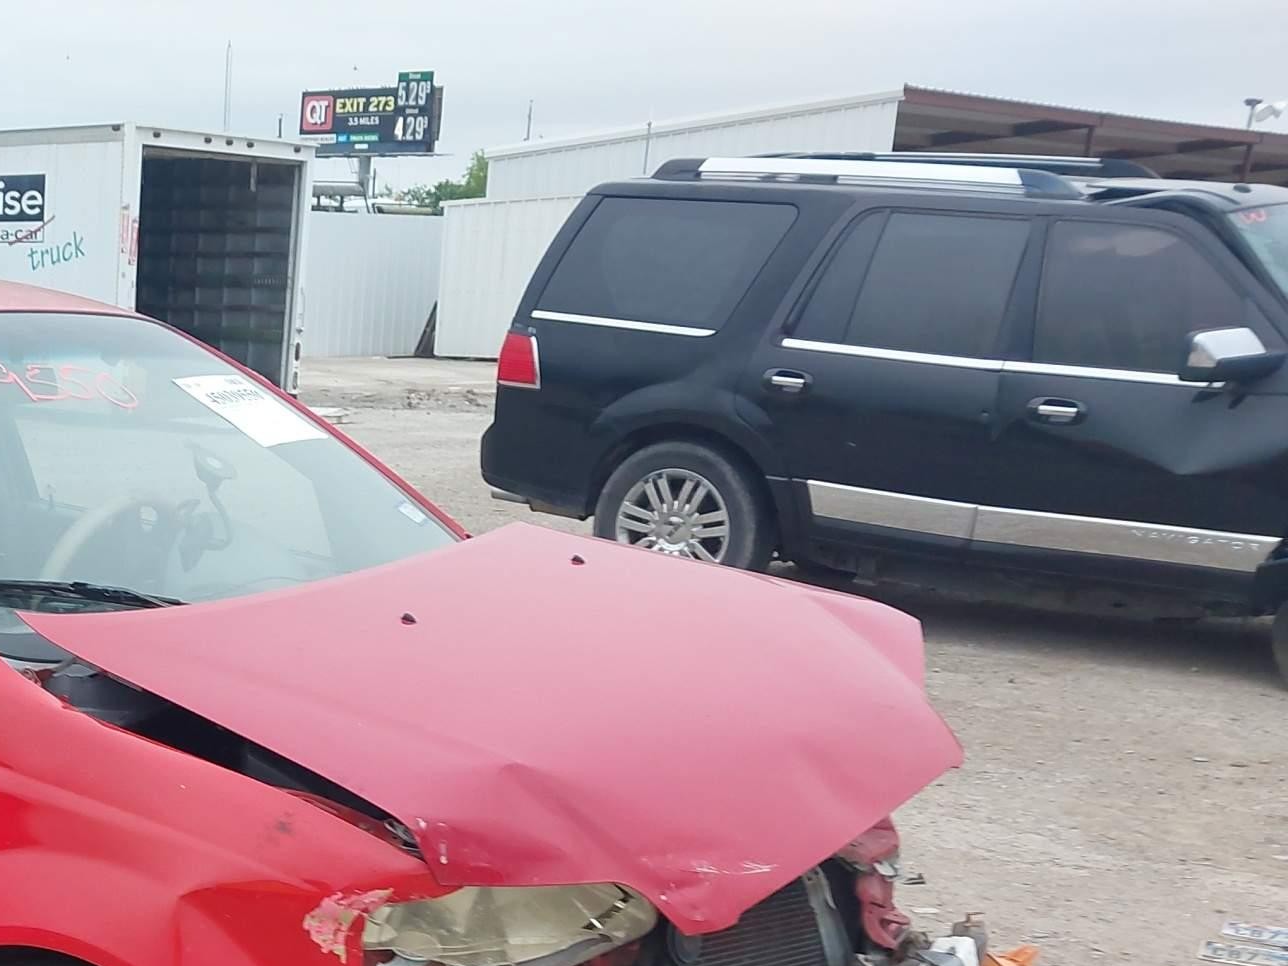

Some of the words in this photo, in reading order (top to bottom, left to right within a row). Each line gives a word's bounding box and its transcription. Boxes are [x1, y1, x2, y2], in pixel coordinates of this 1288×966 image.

[305, 100, 329, 126] QT
[335, 98, 367, 113] EXIT
[368, 96, 396, 112] 273
[359, 116, 380, 125] MILES
[28, 231, 86, 271] truck
